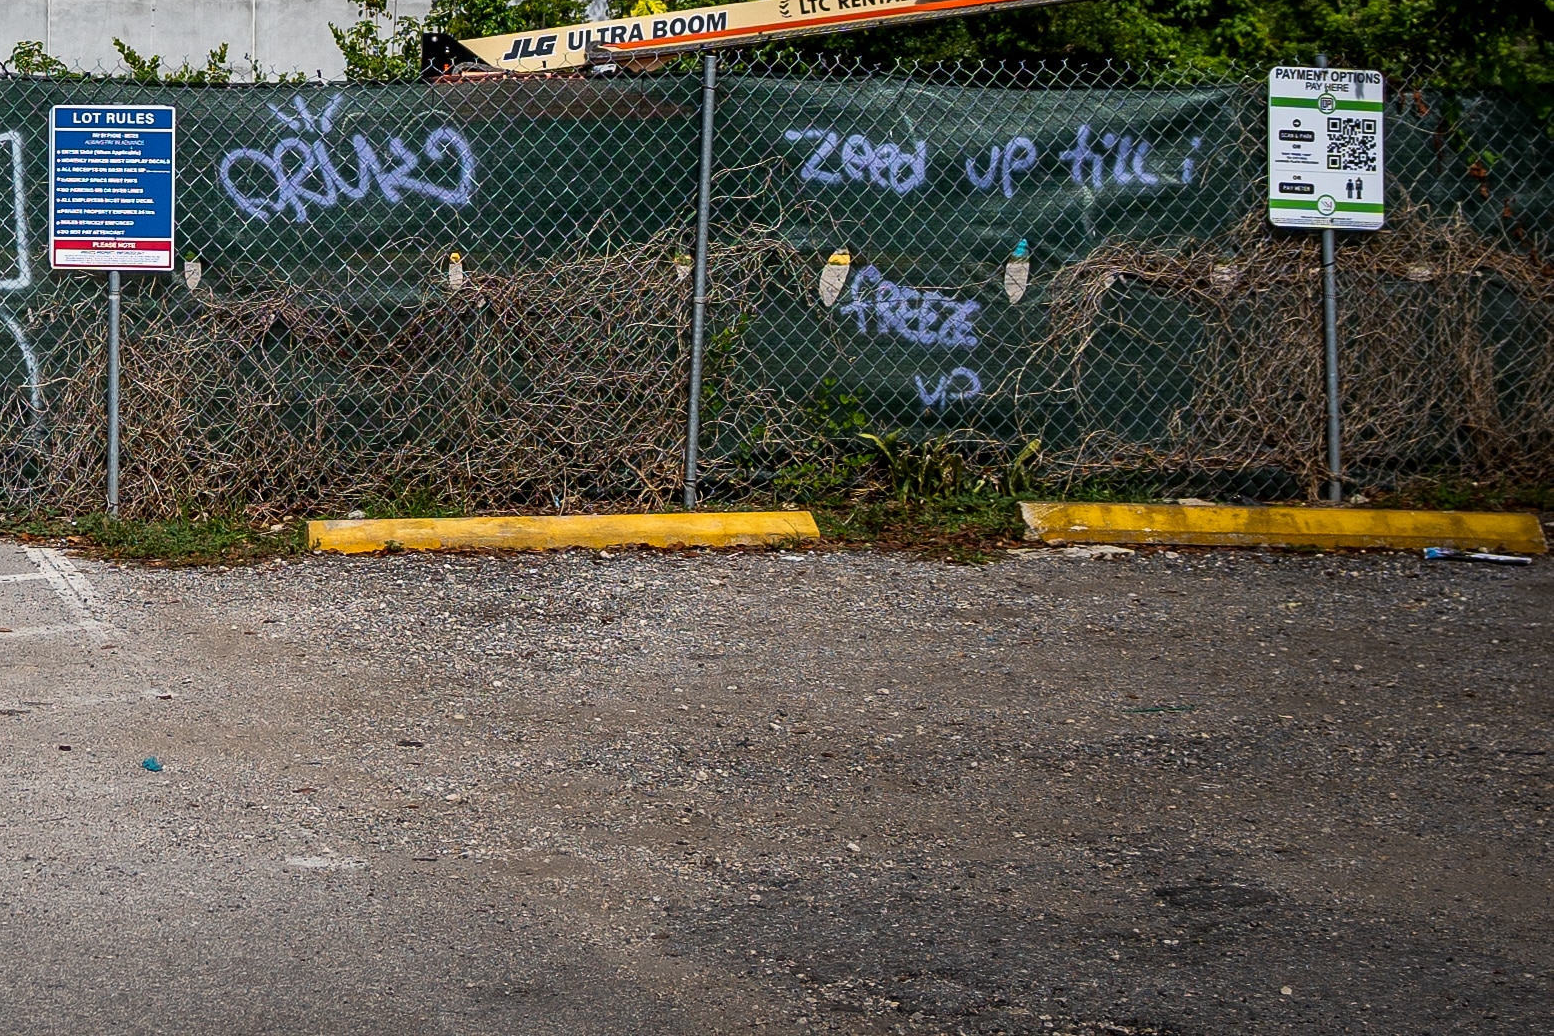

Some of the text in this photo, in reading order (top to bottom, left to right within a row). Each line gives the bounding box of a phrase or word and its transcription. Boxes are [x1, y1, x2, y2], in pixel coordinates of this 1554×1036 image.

[503, 11, 729, 61] JLG ULTRA BOOM
[1275, 67, 1381, 85] PAYMENT OPTIONS
[1305, 82, 1350, 93] PAY HERE
[72, 112, 155, 125] LOT RULES
